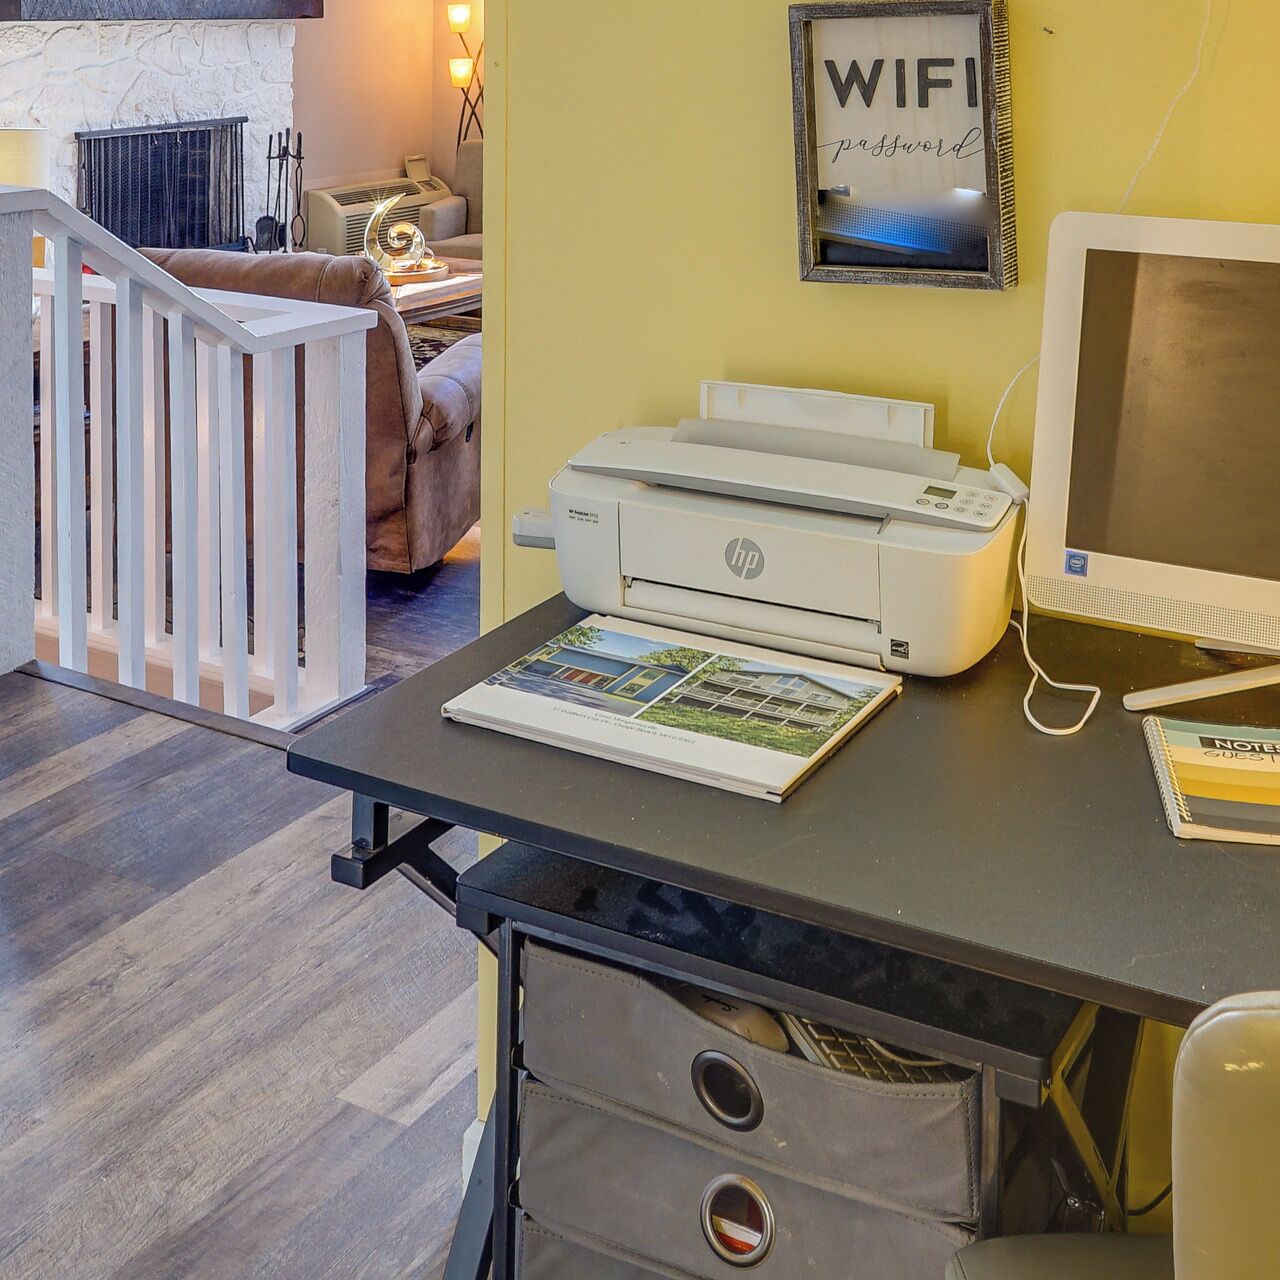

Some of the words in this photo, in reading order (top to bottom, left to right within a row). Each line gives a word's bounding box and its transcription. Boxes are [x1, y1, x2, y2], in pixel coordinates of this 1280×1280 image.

[824, 57, 978, 108] WIFI
[816, 127, 984, 164] password
[729, 537, 761, 580] hp
